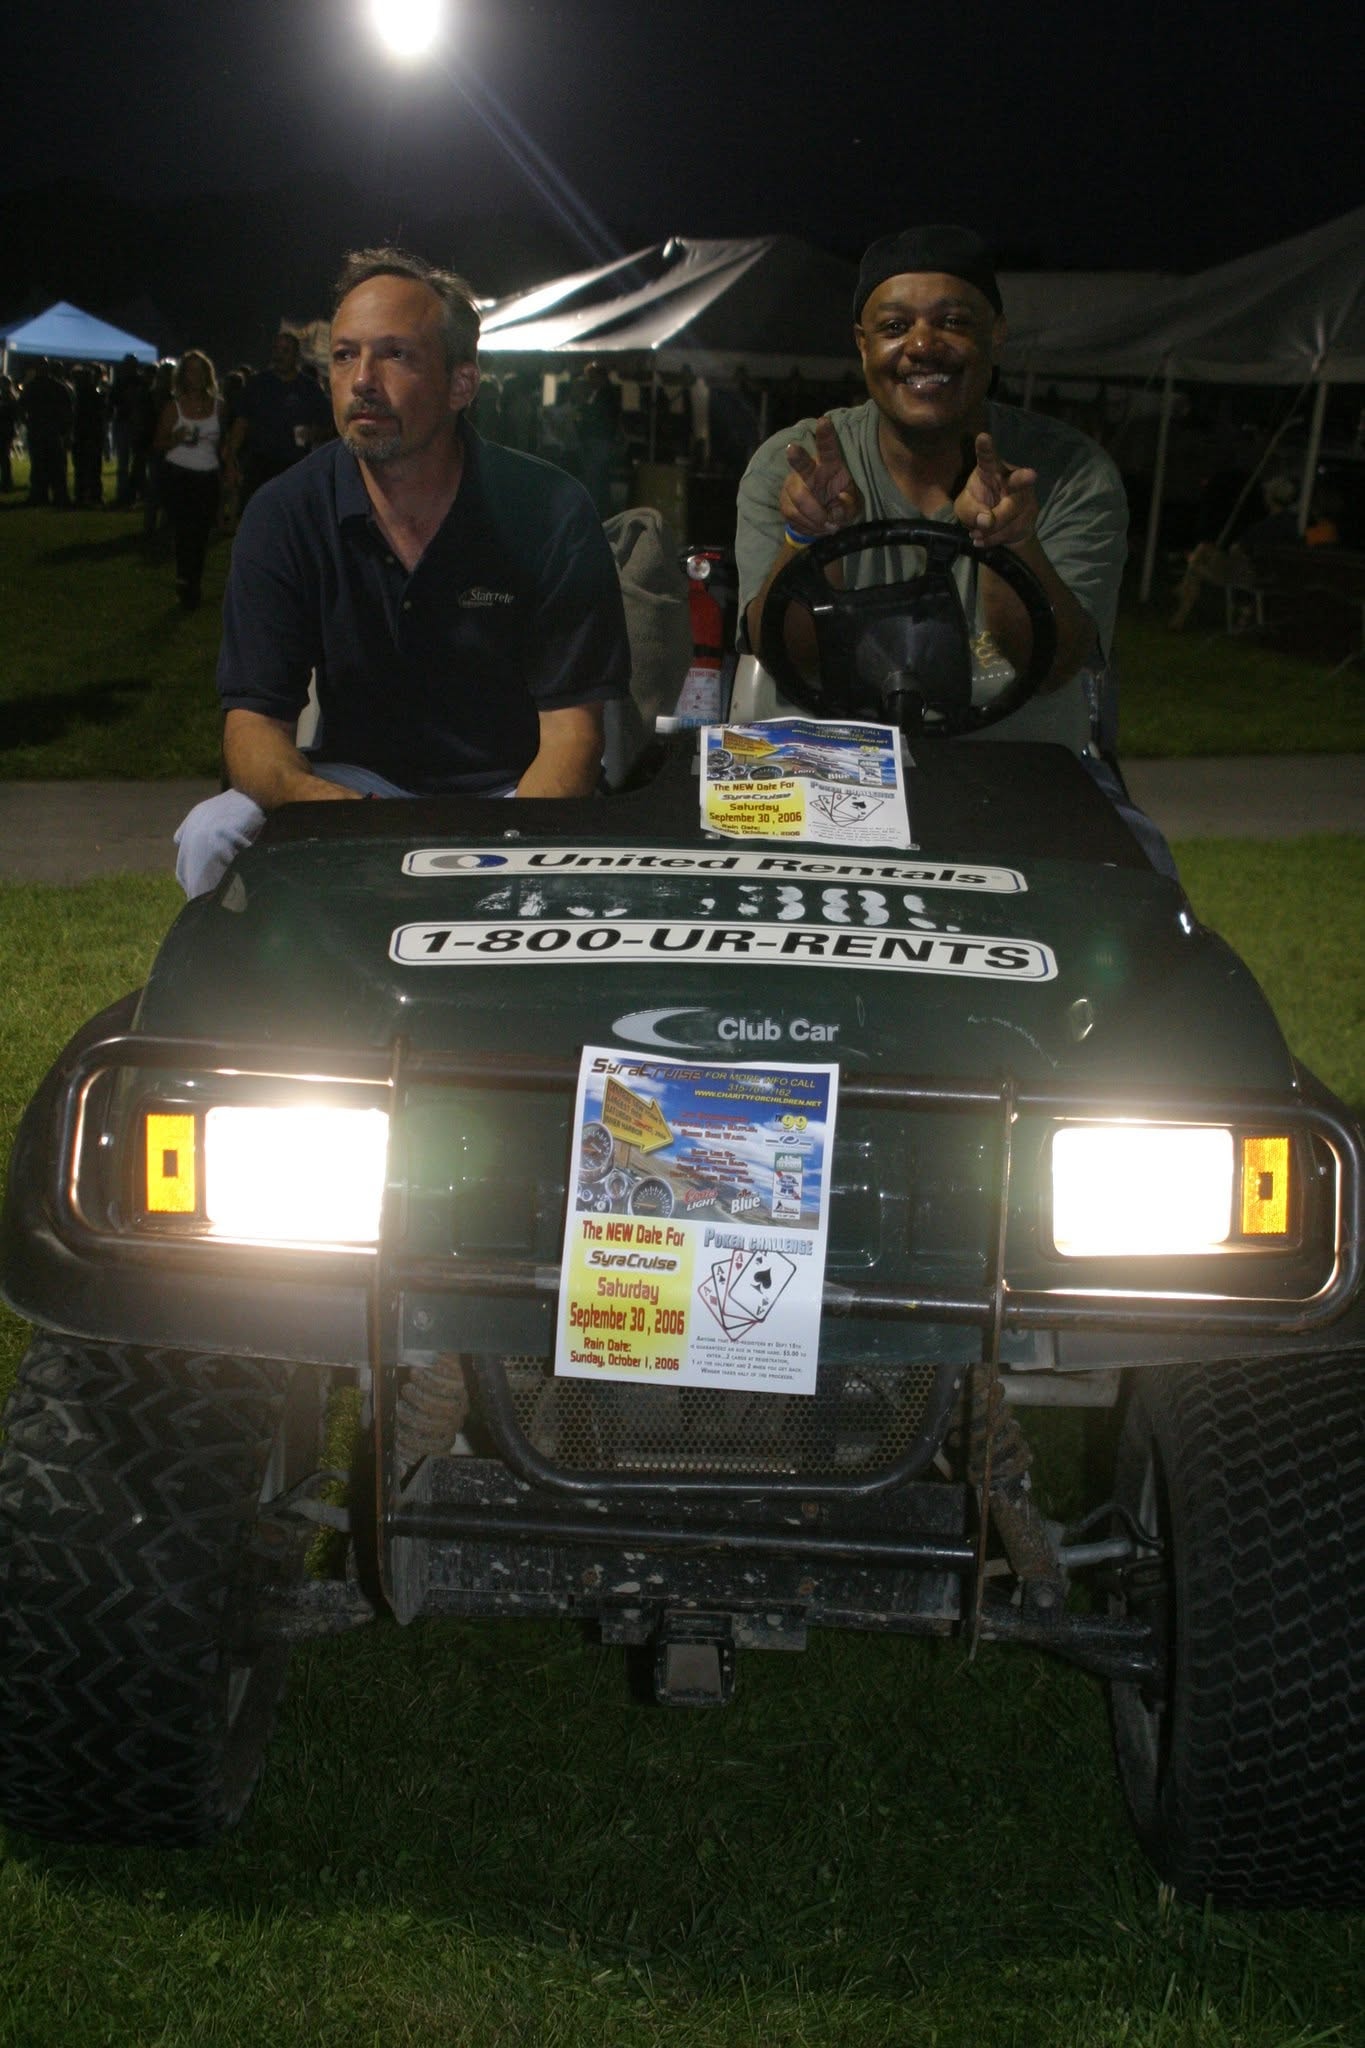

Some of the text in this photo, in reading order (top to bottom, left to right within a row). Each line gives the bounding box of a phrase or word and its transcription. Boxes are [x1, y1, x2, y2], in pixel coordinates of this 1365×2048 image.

[713, 783, 730, 791] The
[733, 783, 754, 791] NEW
[757, 783, 777, 791] Date
[709, 812, 755, 823] September
[778, 811, 802, 823] 2006
[729, 803, 779, 812] Saturday
[527, 853, 987, 885] United Rentals
[421, 927, 1031, 970] 1-800-UR-RENTS
[717, 1017, 840, 1043] Club Car
[591, 1058, 701, 1080] SyraCruise
[705, 1071, 727, 1080] FOR
[790, 1078, 815, 1089] CALL
[687, 1198, 716, 1211] LIGHT
[731, 1196, 760, 1213] Blue
[583, 1220, 685, 1247] The NEW Date For
[589, 1250, 677, 1271] SyraCruise
[597, 1276, 659, 1305] Saturday
[569, 1302, 627, 1334] September
[630, 1306, 645, 1332] 30
[654, 1308, 685, 1335] 2006
[584, 1337, 632, 1352] Rain Date:
[570, 1350, 605, 1368] Sunday,
[608, 1352, 641, 1367] October
[654, 1357, 679, 1371] 2006
